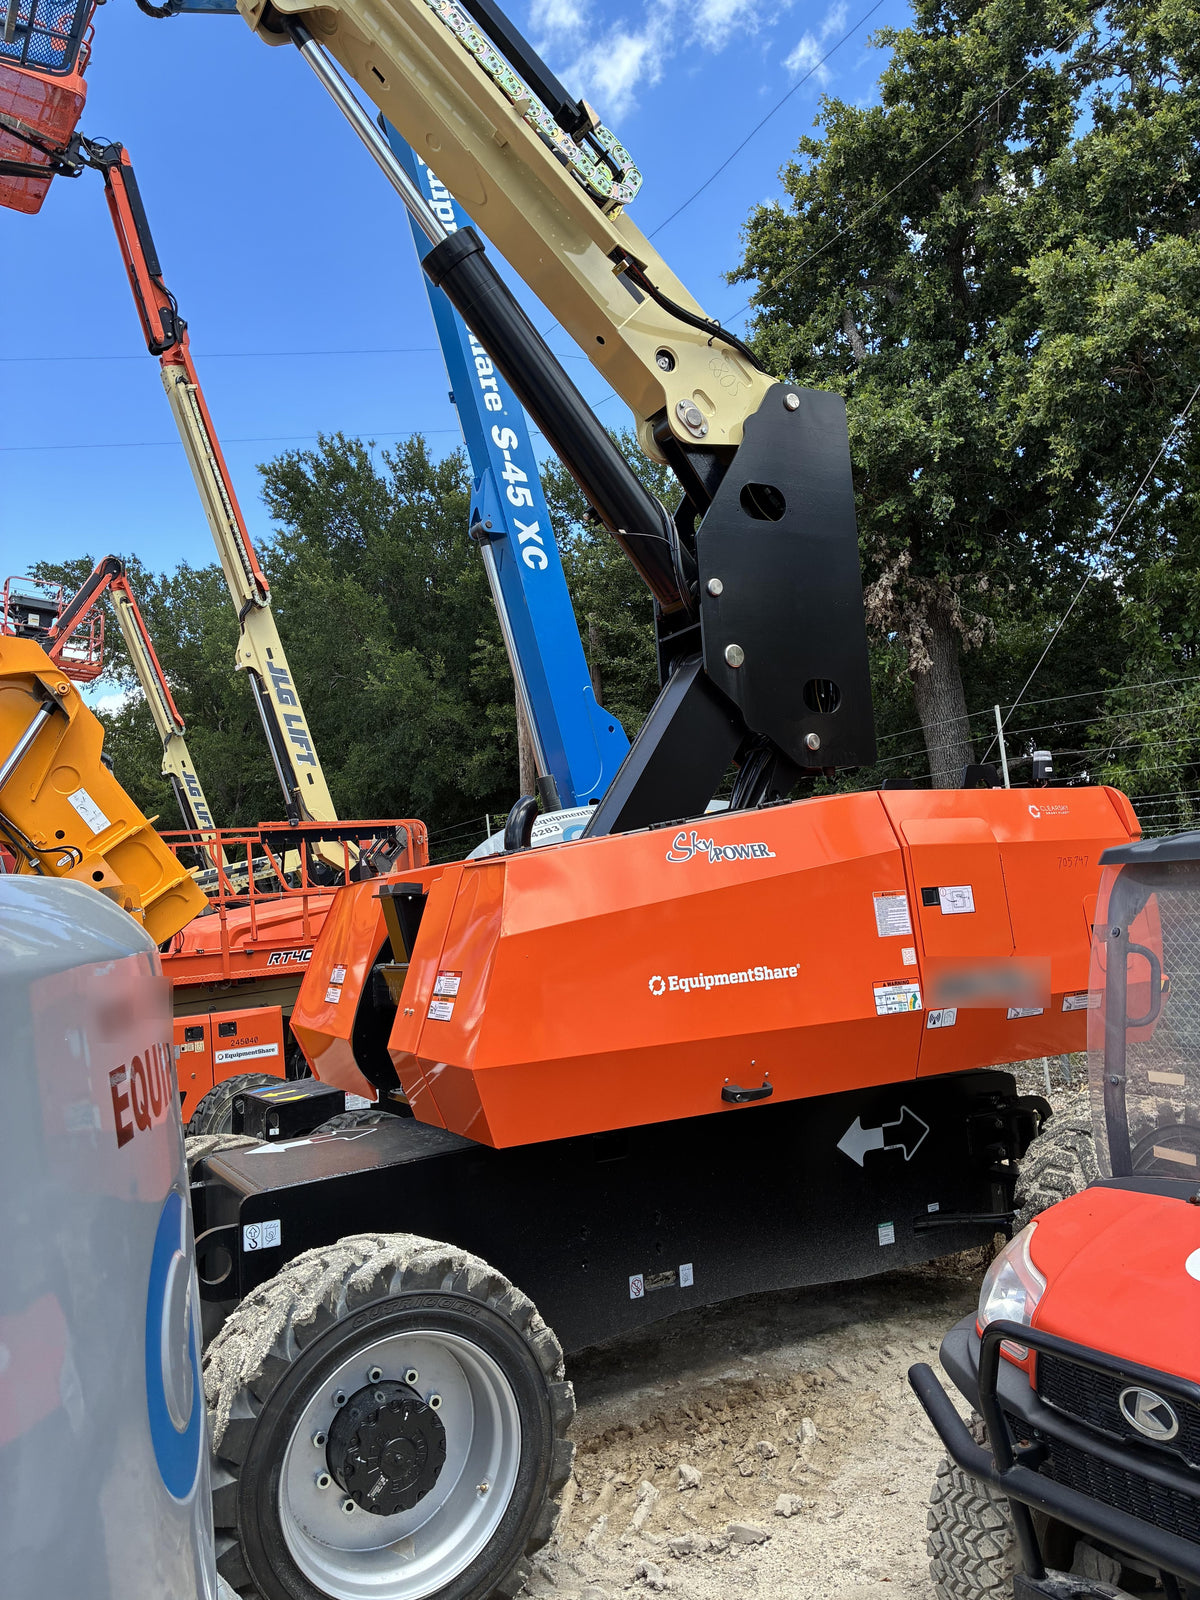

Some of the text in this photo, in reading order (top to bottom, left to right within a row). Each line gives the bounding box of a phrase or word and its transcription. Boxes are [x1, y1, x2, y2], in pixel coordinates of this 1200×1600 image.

[491, 424, 535, 507] S-45
[513, 517, 549, 571] XC
[266, 660, 317, 767] JLG LIFT
[181, 770, 202, 797] JLG
[533, 809, 596, 827] EquipmentS
[1057, 855, 1089, 870] 705747
[667, 965, 799, 993] EquipmentShare
[230, 1036, 259, 1047] 245040
[224, 1047, 276, 1059] EquipmentShare
